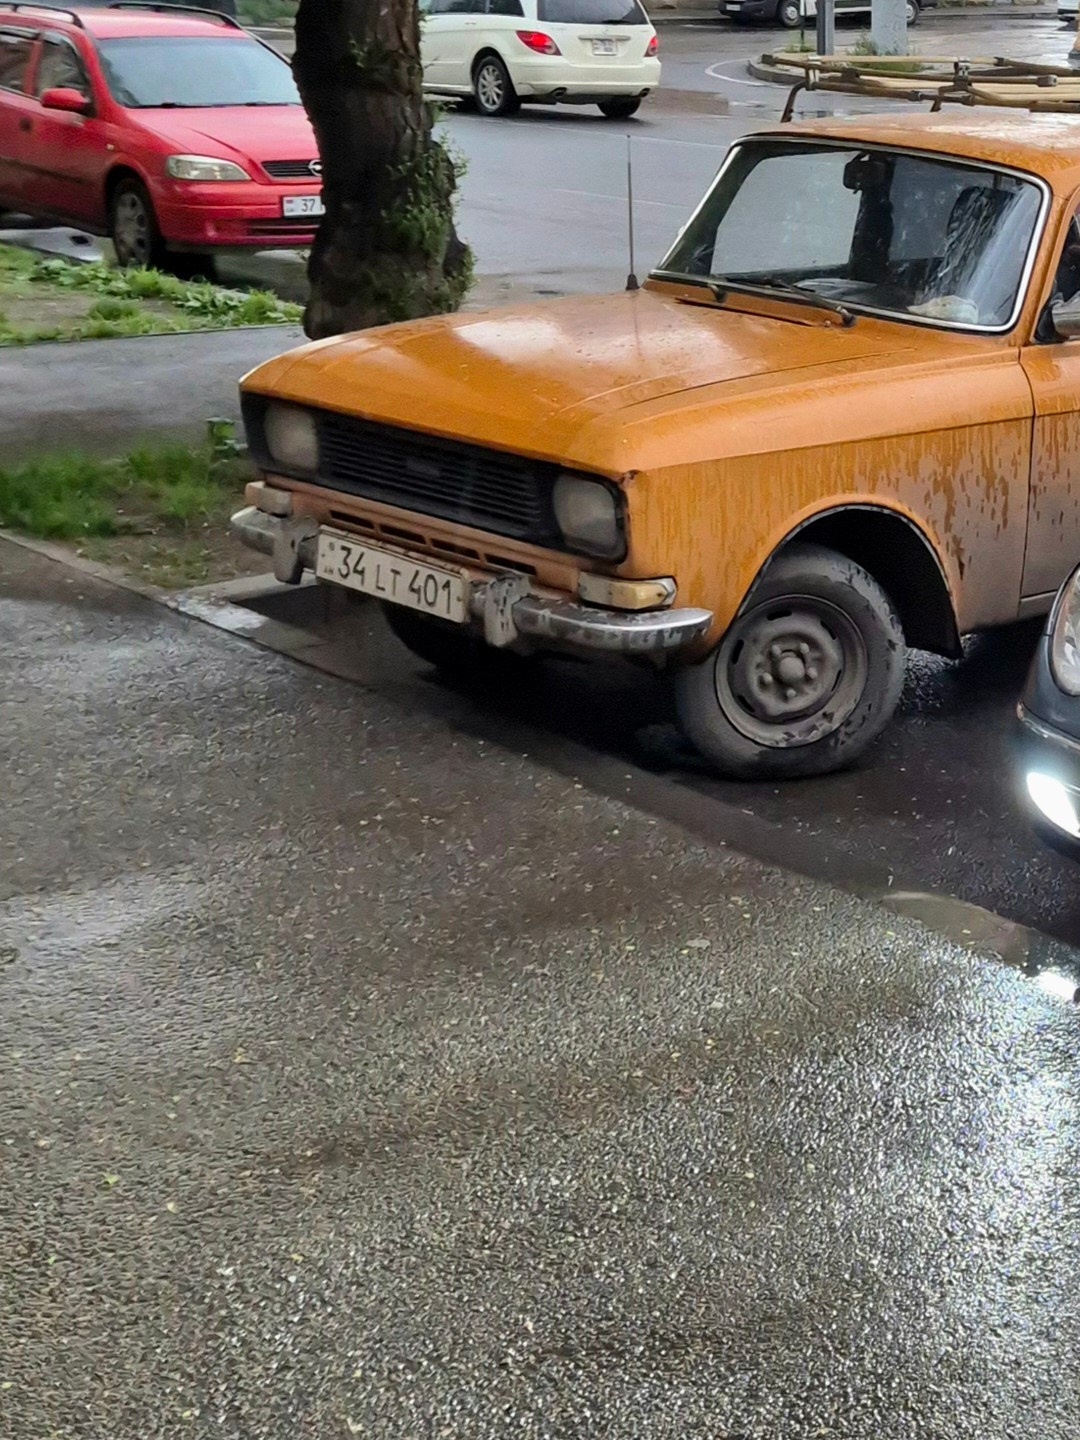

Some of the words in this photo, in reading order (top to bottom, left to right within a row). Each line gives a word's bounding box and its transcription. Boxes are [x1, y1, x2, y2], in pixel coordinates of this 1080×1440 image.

[301, 198, 316, 213] 37
[338, 545, 366, 587] 34
[375, 564, 402, 597] LT
[408, 569, 451, 614] 401
